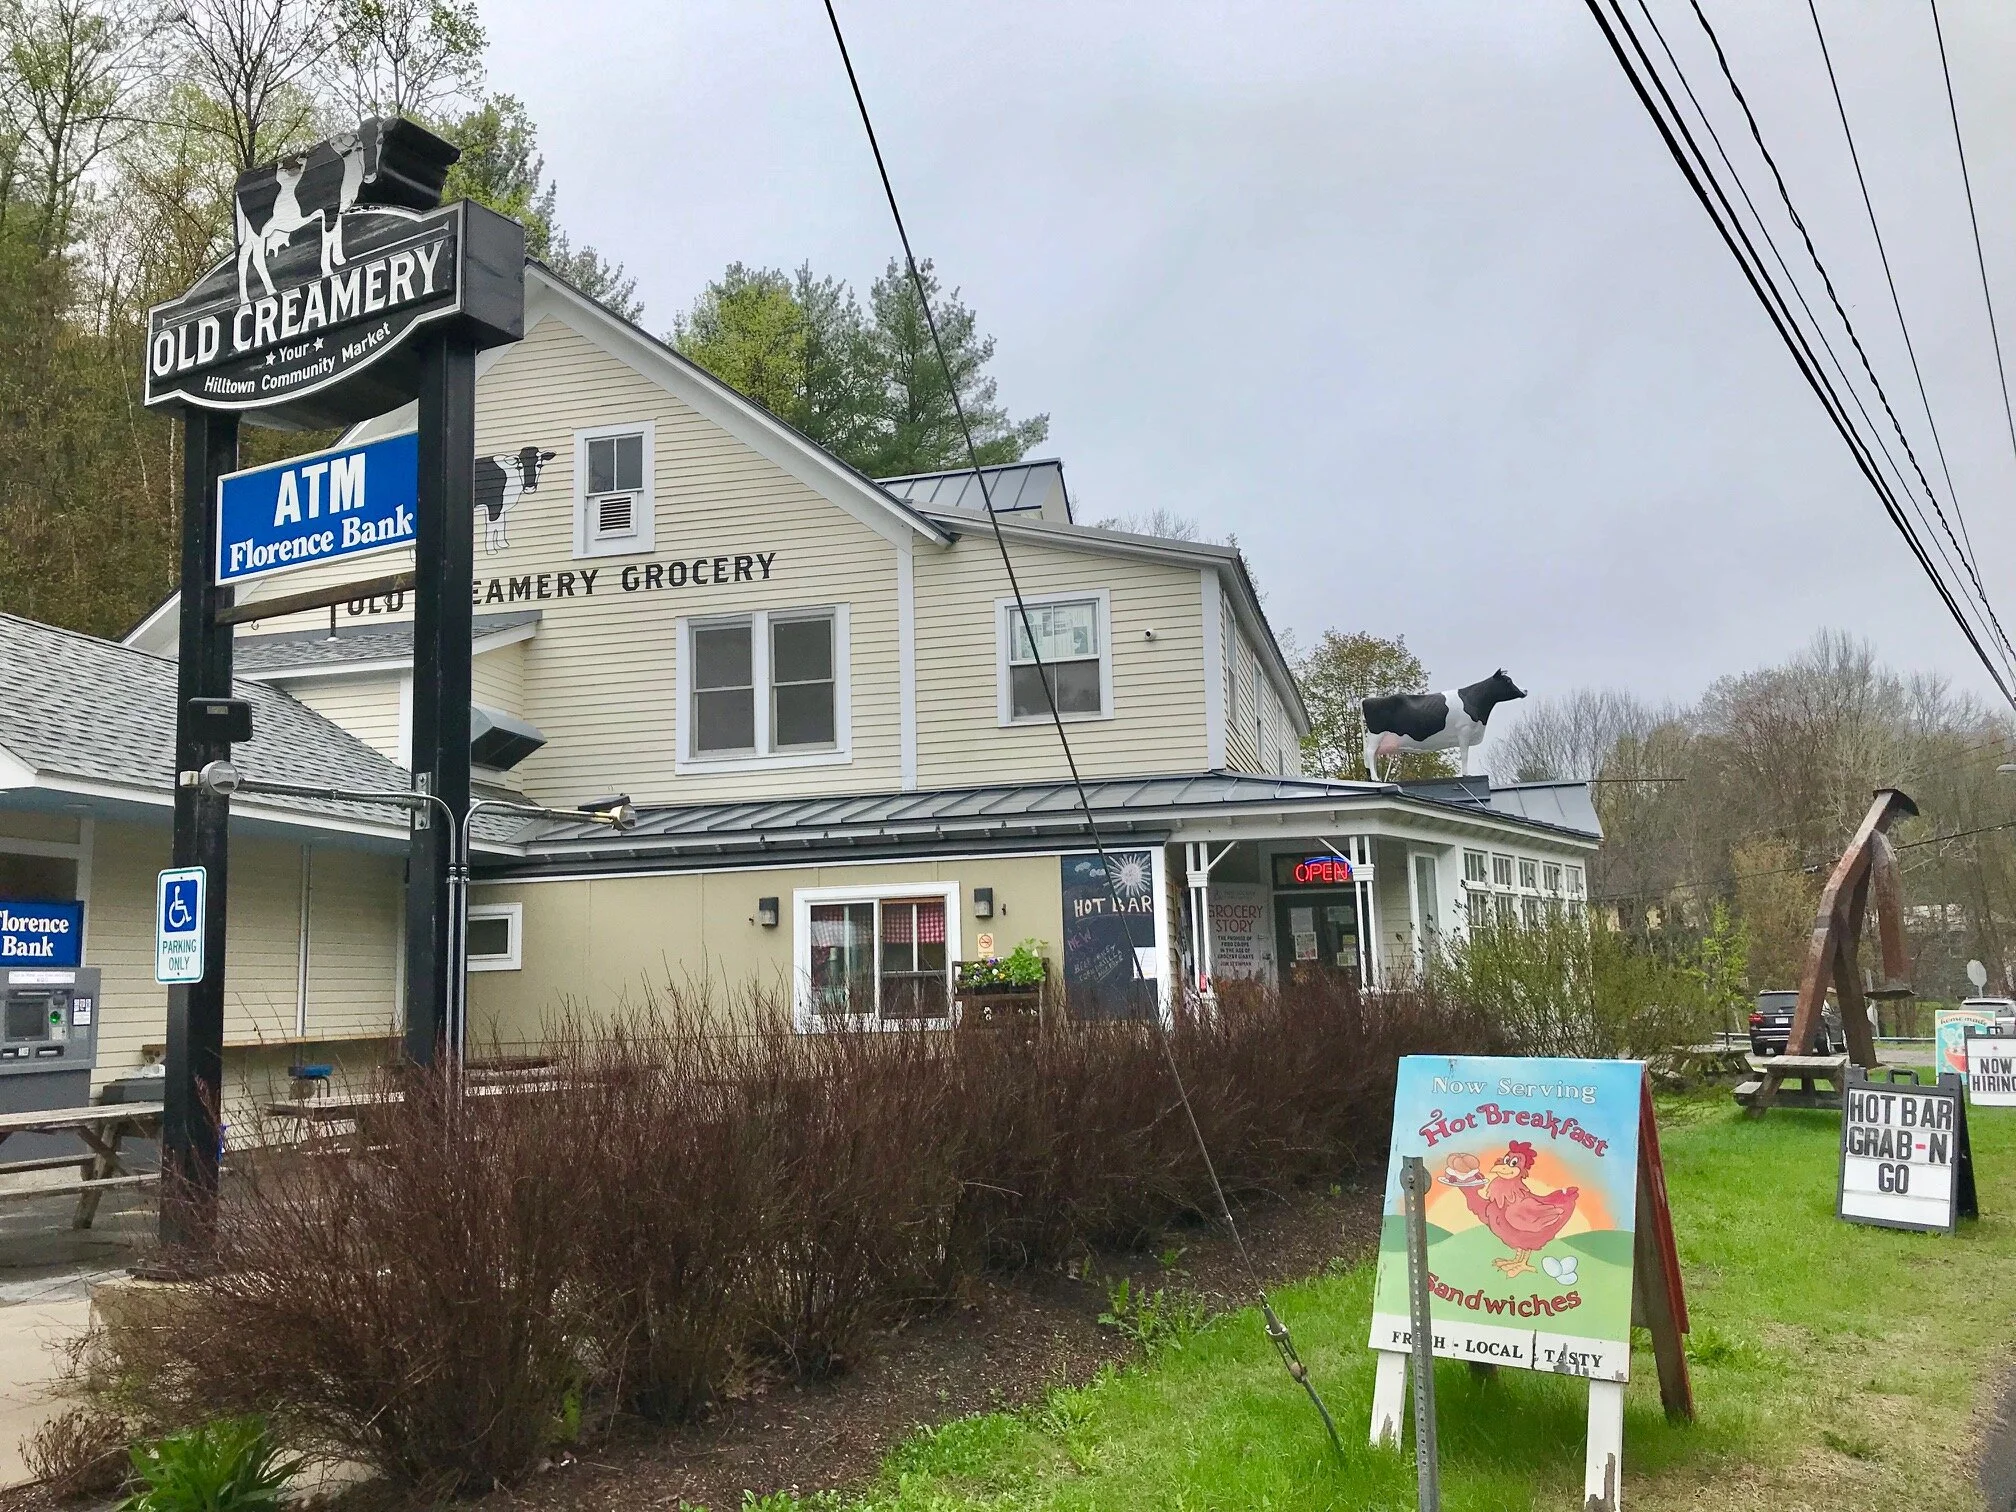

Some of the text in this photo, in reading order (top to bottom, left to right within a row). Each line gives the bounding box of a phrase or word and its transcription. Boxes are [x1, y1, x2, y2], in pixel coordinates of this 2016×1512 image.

[153, 239, 445, 377] OLD CREAMERY
[204, 321, 391, 394] Hilltown Community Market
[279, 341, 310, 363] Your
[274, 453, 366, 527] ATM
[229, 504, 414, 573] Florence Bank
[473, 569, 599, 605] EAMERY
[622, 553, 776, 592] GROCERY
[1295, 863, 1348, 882] OPEN
[1073, 894, 1153, 918] HOT BAR
[1208, 904, 1263, 918] GROCERY
[0, 910, 69, 933] lorence
[1216, 919, 1254, 933] STORY
[2, 936, 54, 957] Bank
[162, 939, 197, 954] PARKING
[168, 957, 190, 971] ONLY
[1980, 1058, 2012, 1074] NOW
[1432, 1076, 1597, 1104] Now Serving
[1850, 1093, 1953, 1130] HOT BAR
[1419, 1102, 1609, 1157] Hot Breakfast
[1878, 1162, 1910, 1194] GO
[1391, 1330, 1446, 1349] FRH
[1465, 1339, 1523, 1359] LOCAL
[1544, 1349, 1603, 1368] TASTY
